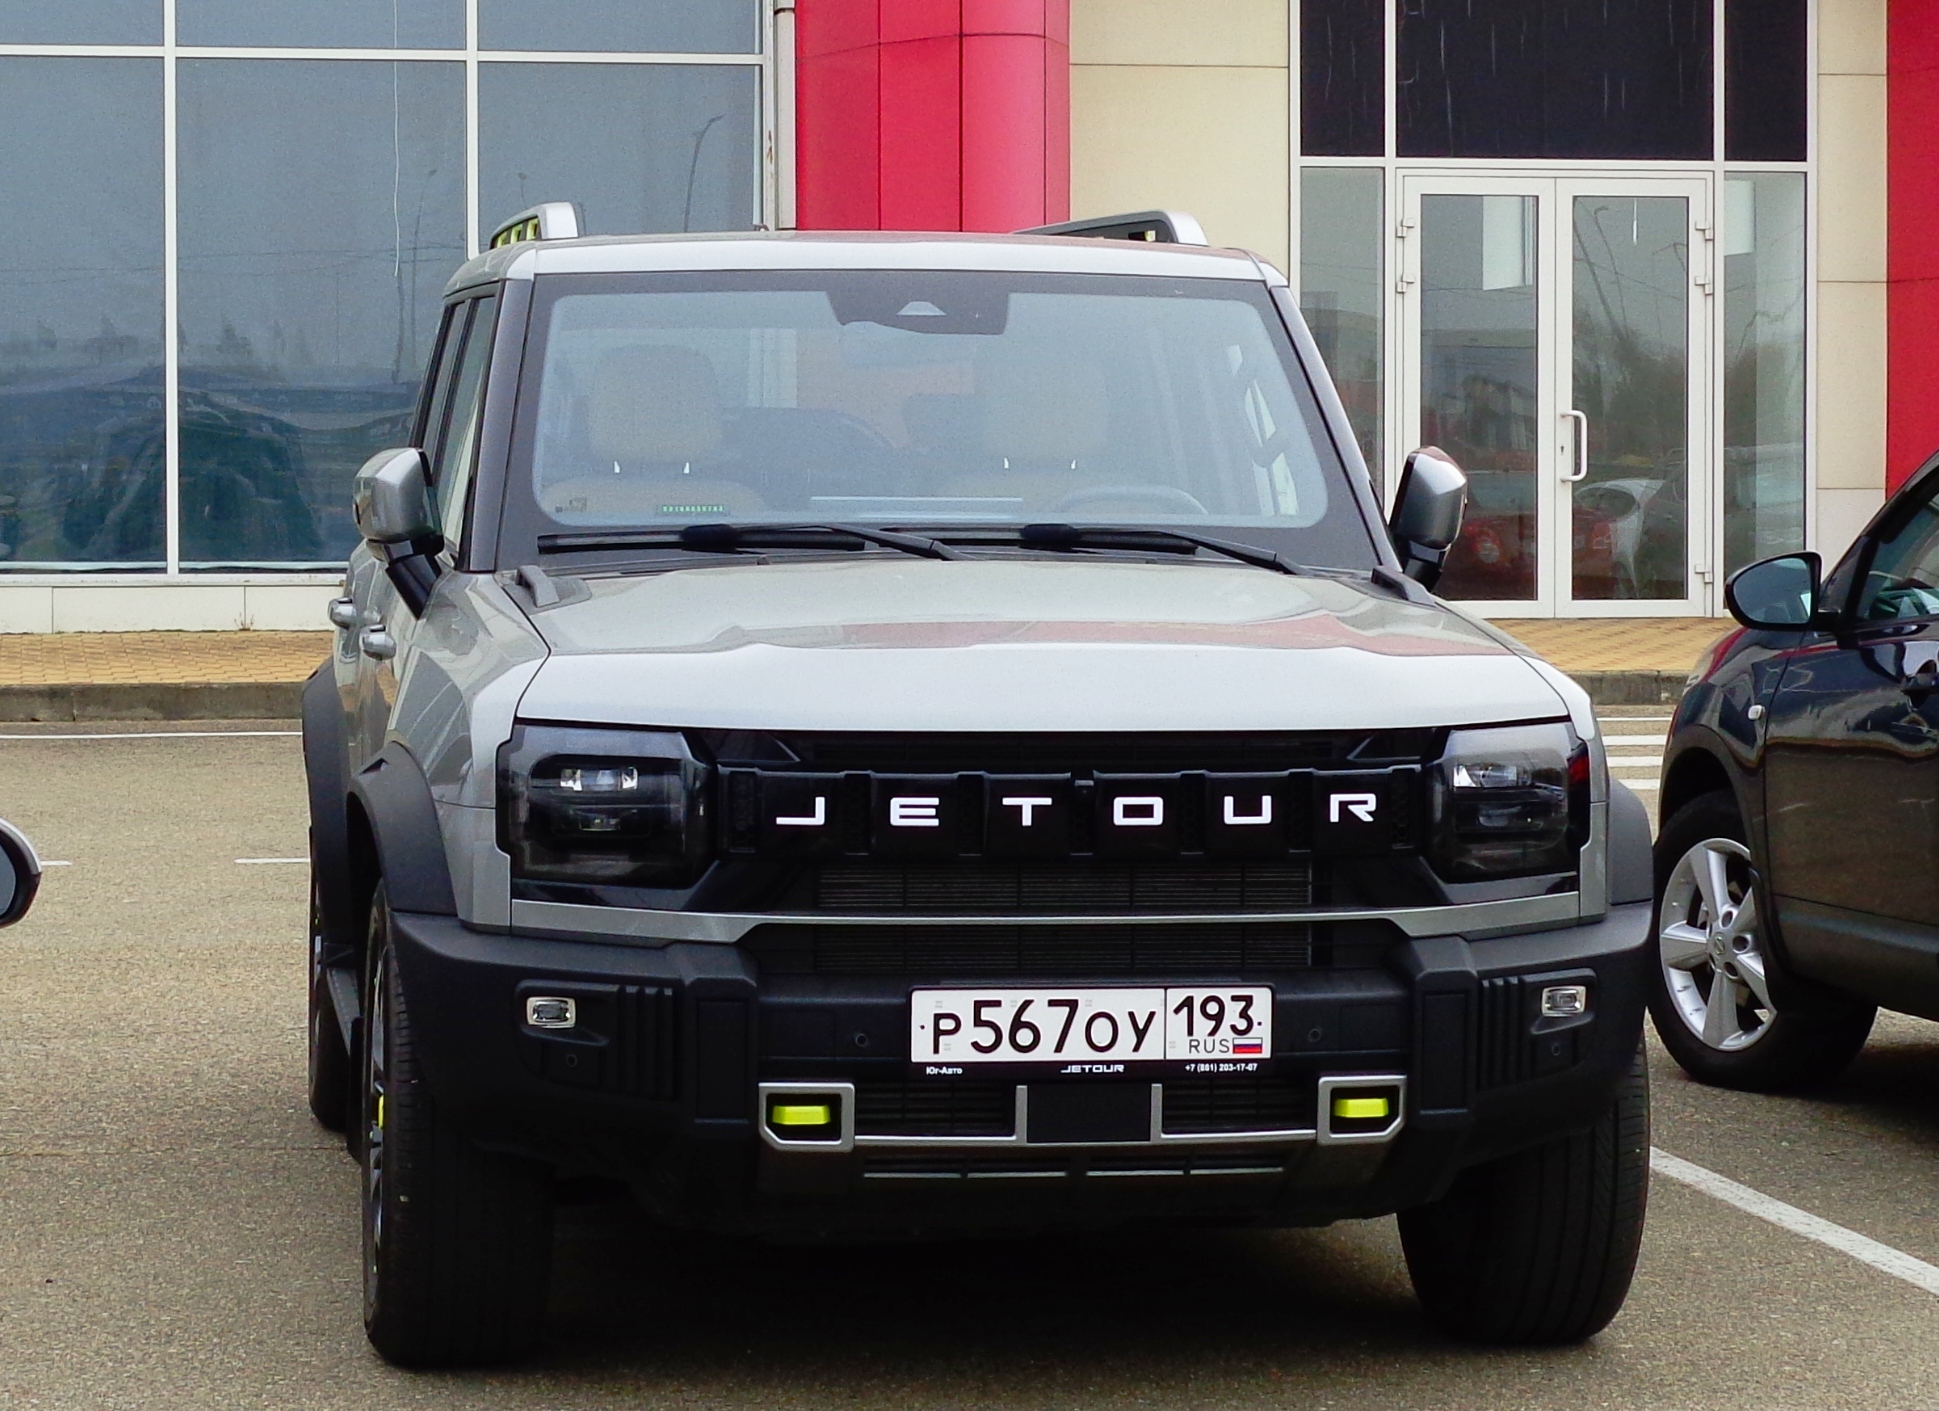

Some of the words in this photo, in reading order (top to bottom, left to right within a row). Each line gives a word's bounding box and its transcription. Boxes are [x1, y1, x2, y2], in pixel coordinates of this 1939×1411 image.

[776, 793, 1377, 826] JETOUR
[1173, 995, 1254, 1037] 193
[1188, 1038, 1231, 1054] RUS
[926, 1066, 963, 1075] Юг-Авто
[1060, 1064, 1125, 1073] JETOUR
[1185, 1063, 1196, 1072] +7
